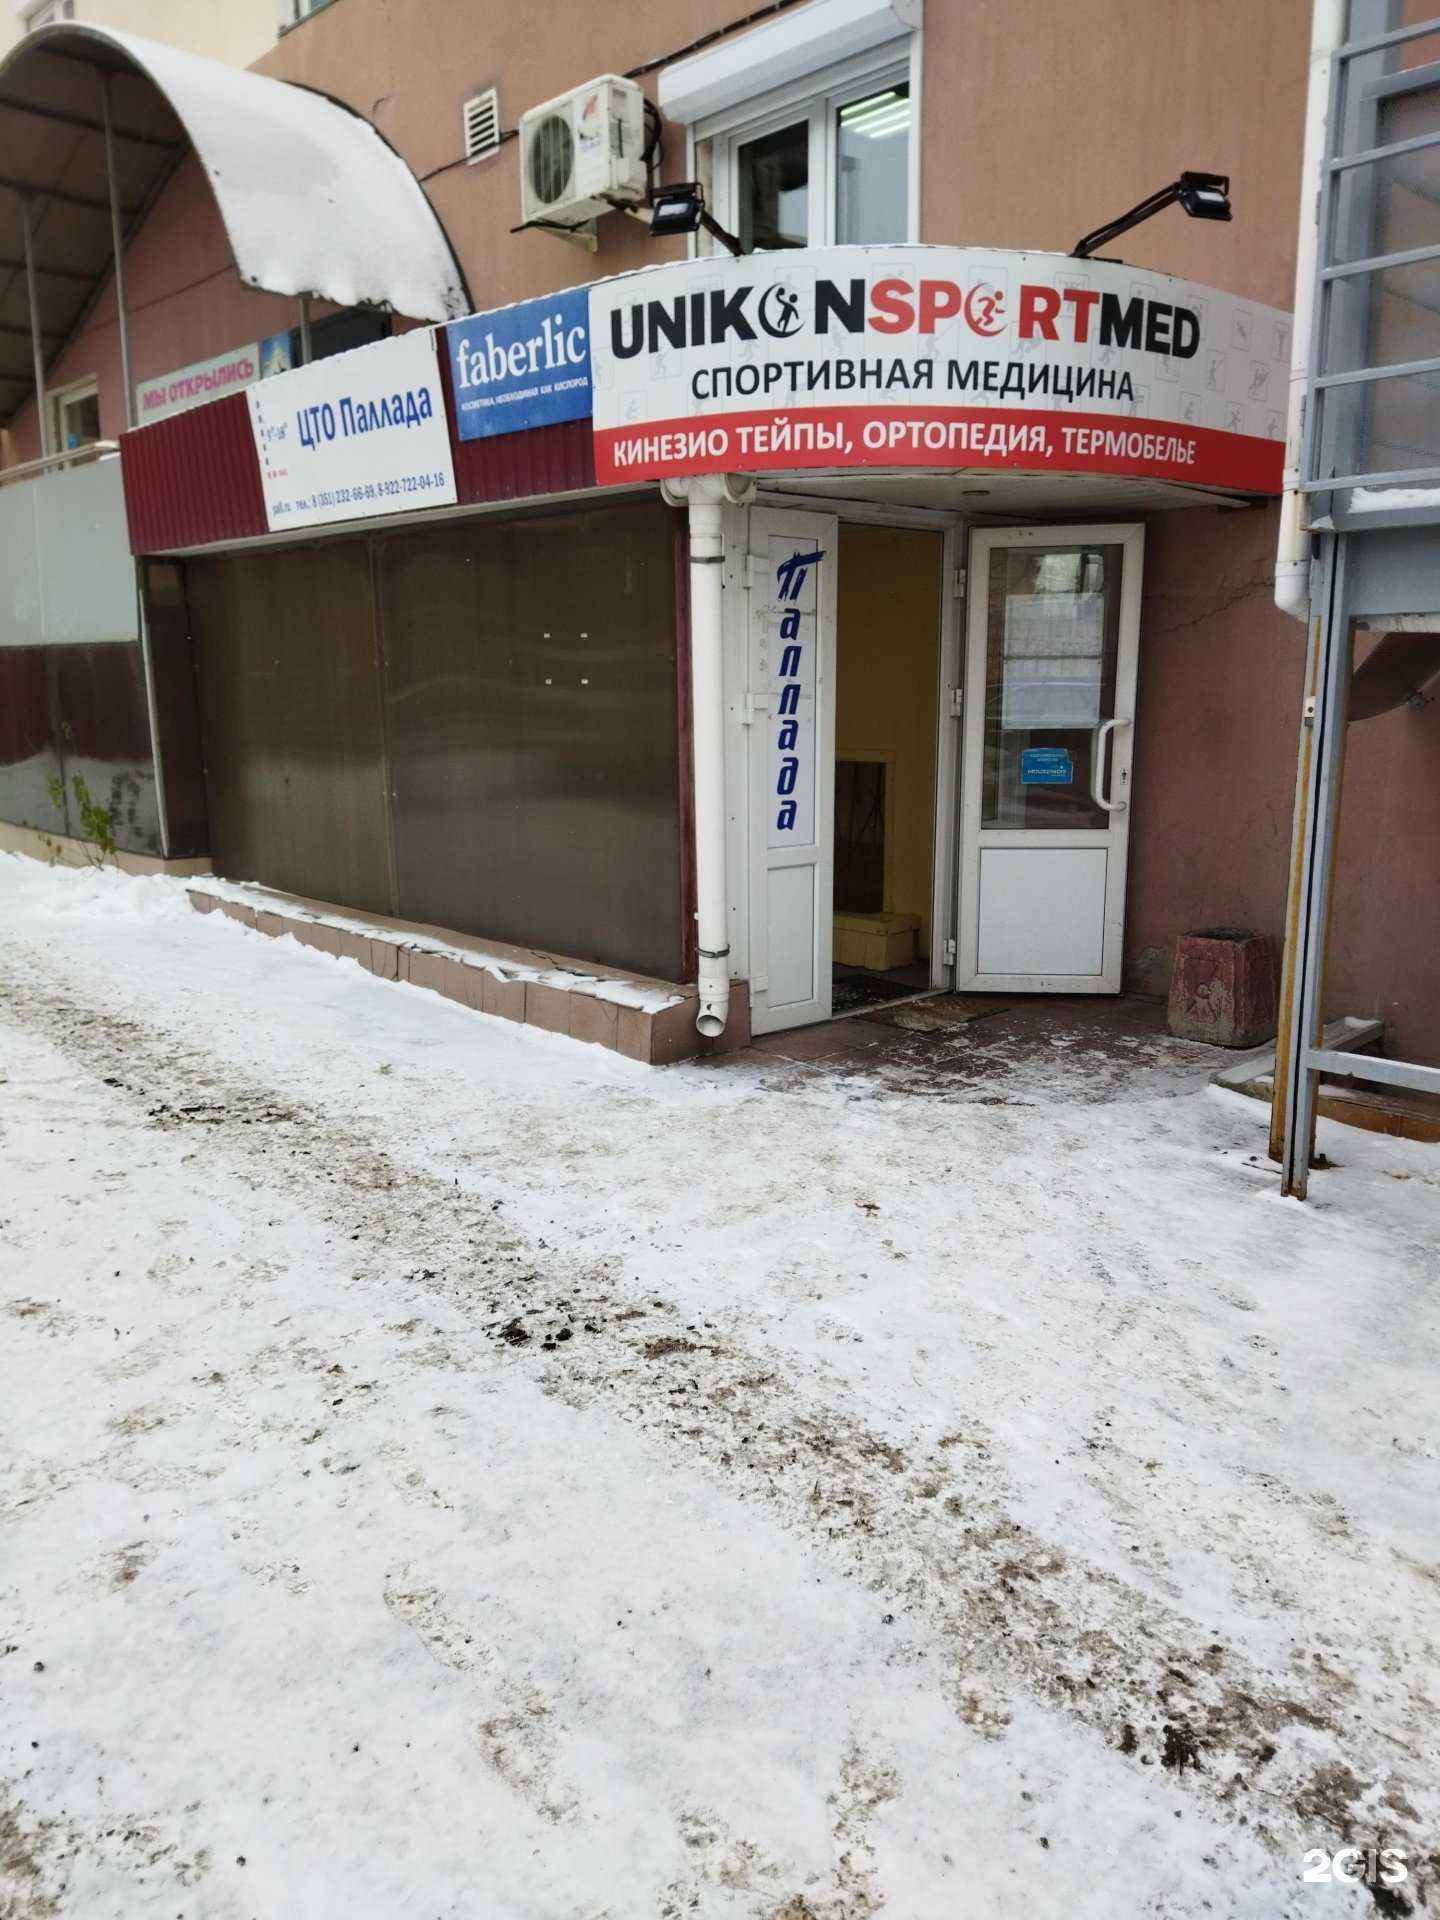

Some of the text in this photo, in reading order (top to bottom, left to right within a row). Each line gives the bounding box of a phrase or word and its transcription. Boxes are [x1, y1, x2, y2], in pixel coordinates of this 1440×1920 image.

[456, 313, 587, 388] faberlic
[169, 358, 254, 402] ОТКРЫЛИСЬ
[692, 358, 1134, 402] СПОРТИВНАЯ МЕДИЦИНА
[297, 402, 336, 451] ЦТО
[339, 387, 433, 437] Паллада
[613, 416, 1197, 467] КИНЕЗИО ТЕЙПЫ, ОРТОПЕДИЯ, ТЕРМОБЕЛЬЕ
